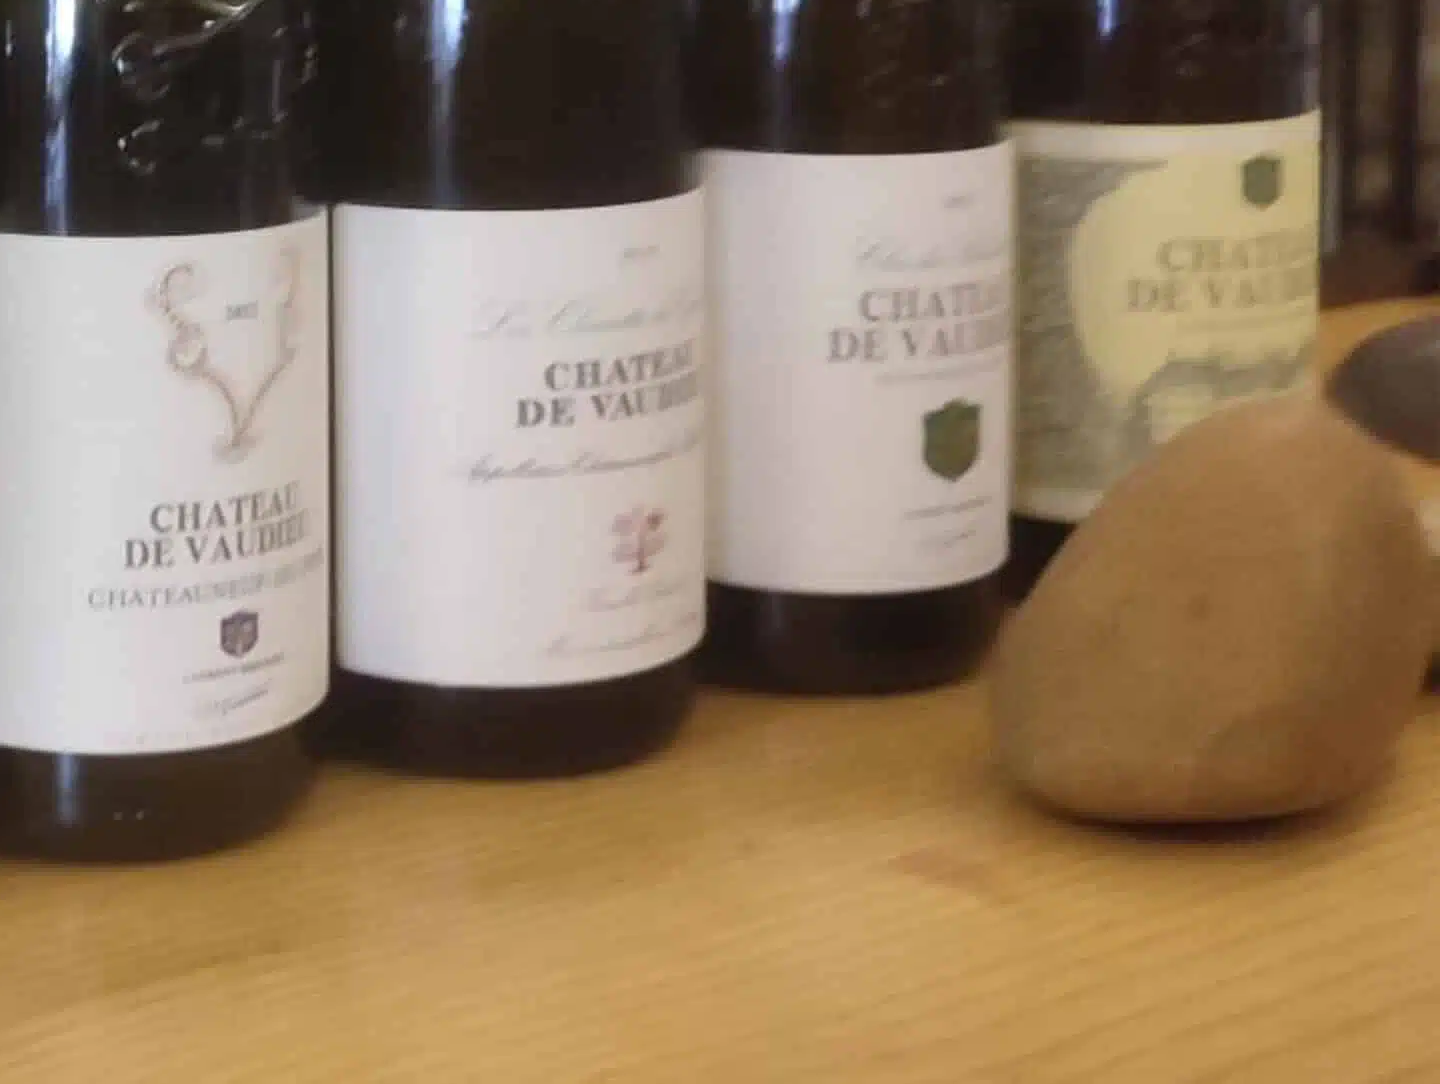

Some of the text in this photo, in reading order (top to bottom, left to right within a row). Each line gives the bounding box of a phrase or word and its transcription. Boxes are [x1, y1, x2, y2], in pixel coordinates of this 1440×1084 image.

[826, 327, 887, 364] DE
[515, 398, 576, 429] DE
[149, 479, 301, 534] CHATEAU
[124, 538, 175, 569] DE
[185, 507, 309, 564] VAUDIEU
